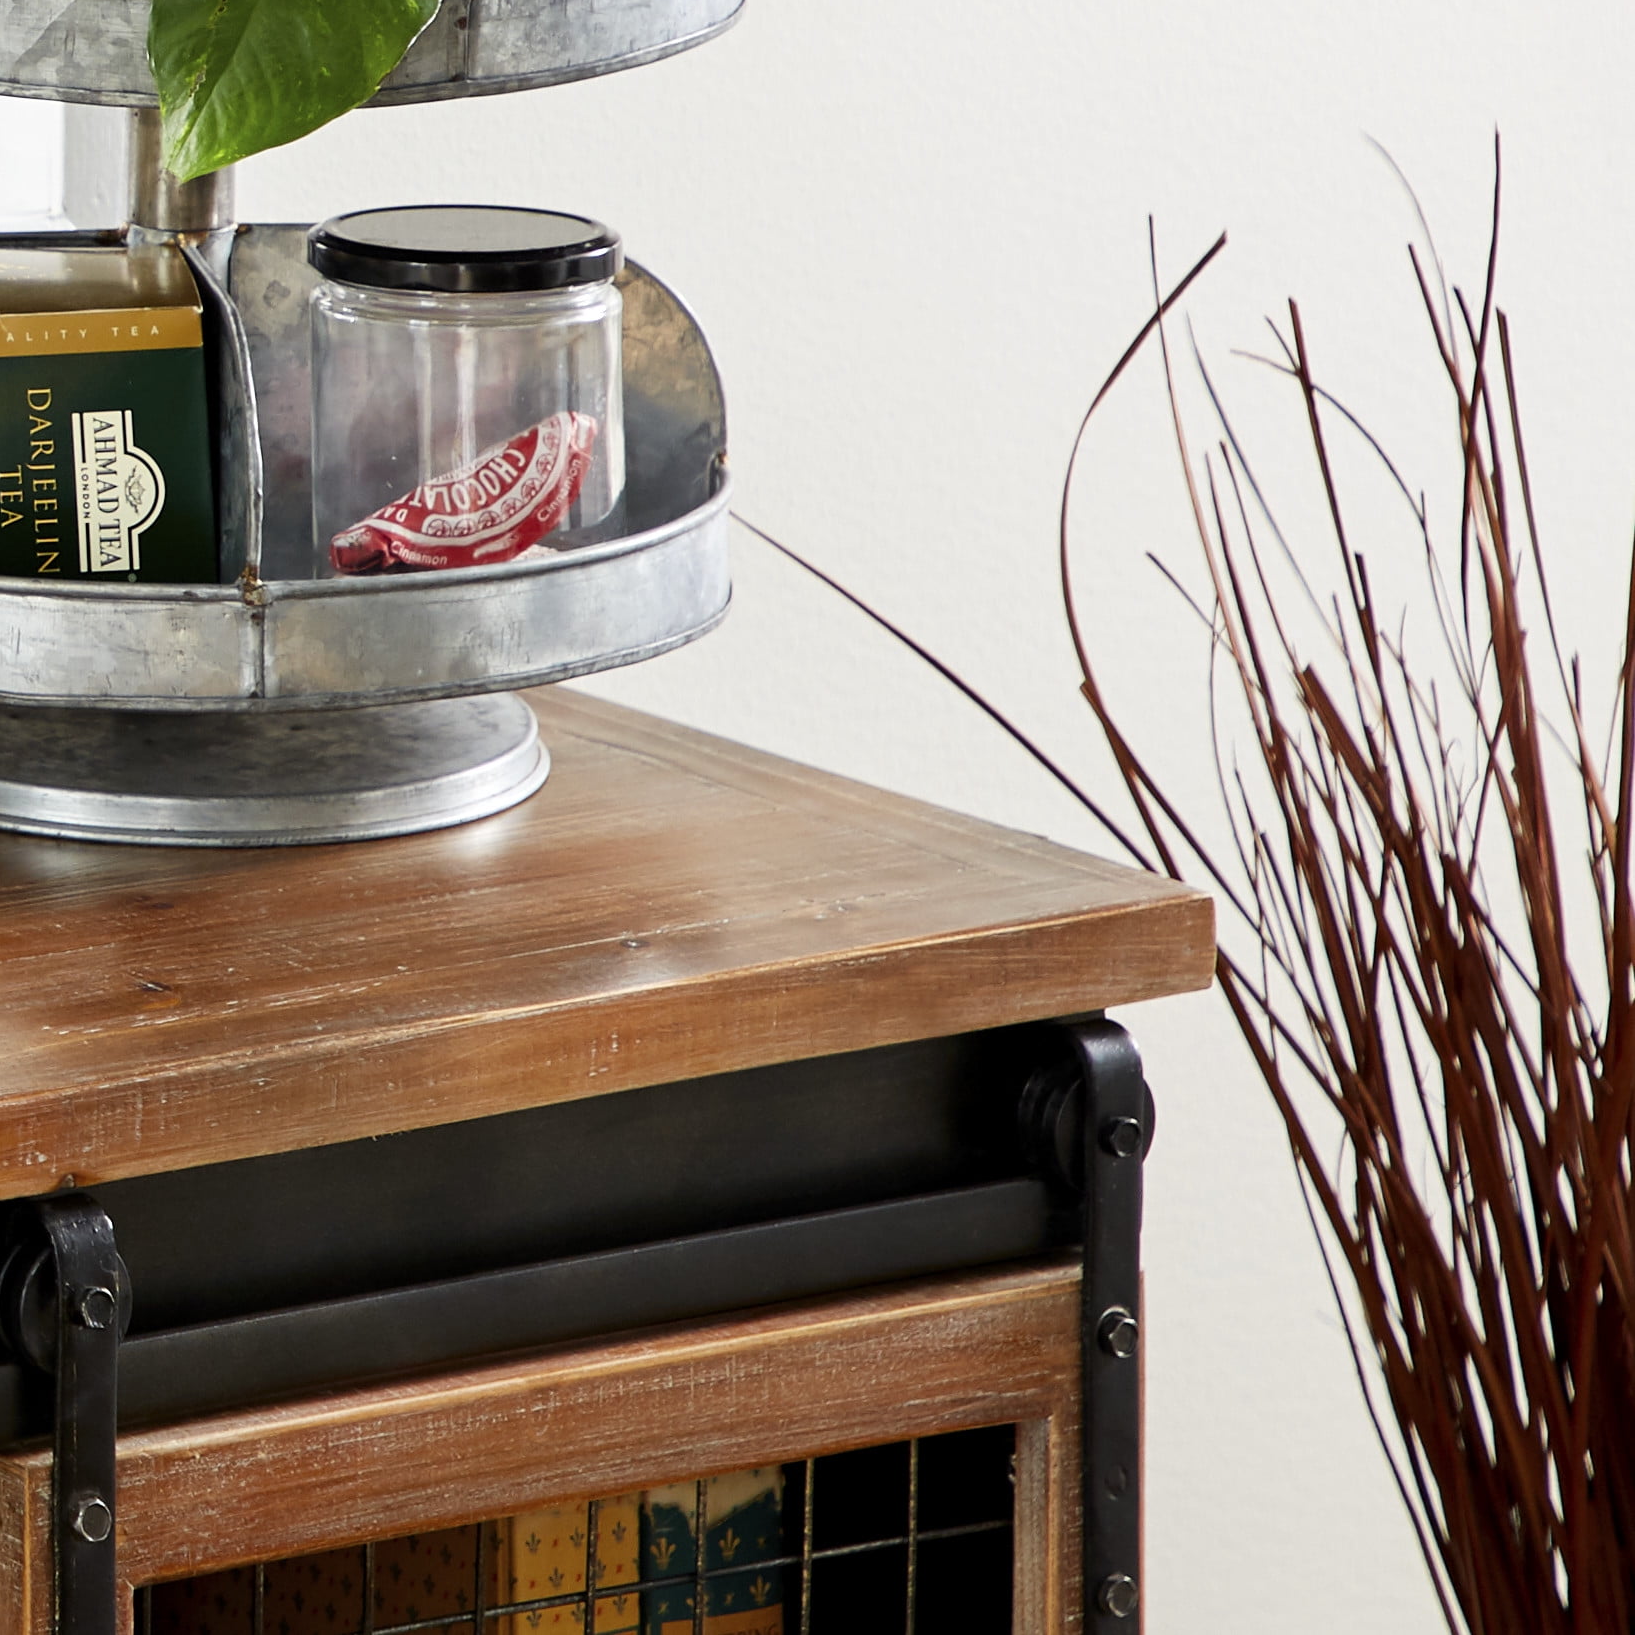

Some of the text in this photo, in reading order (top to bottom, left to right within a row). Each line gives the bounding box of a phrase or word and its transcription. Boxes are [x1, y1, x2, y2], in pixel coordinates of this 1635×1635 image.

[111, 324, 161, 338] TEA
[26, 387, 61, 573] DARJEELIN
[79, 467, 92, 520] LONDON
[93, 417, 123, 568] AHMAD TEA
[537, 458, 582, 523] Cinnamon
[372, 507, 409, 524] DA
[391, 540, 449, 566] Cinnamon
